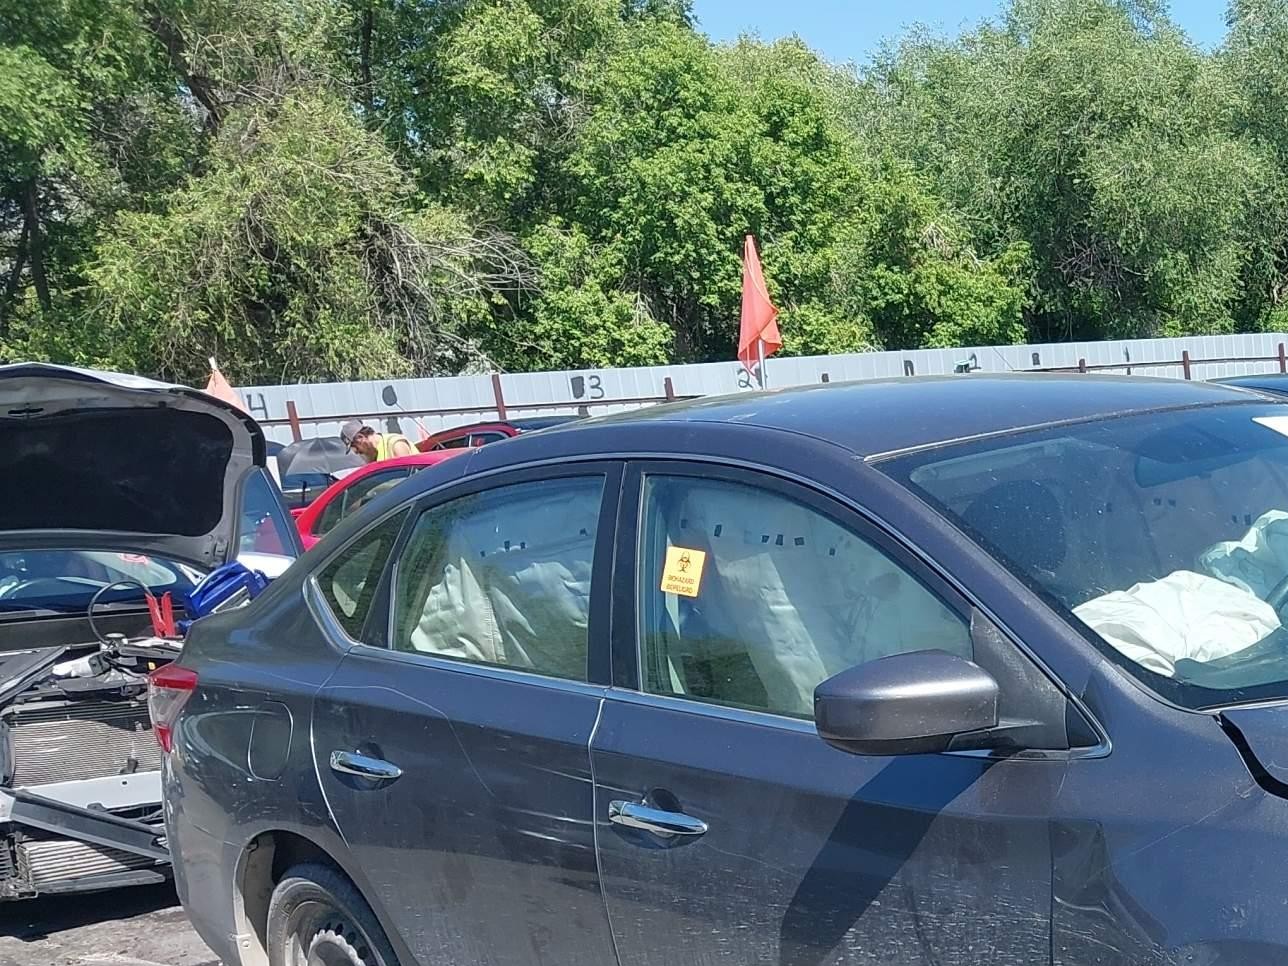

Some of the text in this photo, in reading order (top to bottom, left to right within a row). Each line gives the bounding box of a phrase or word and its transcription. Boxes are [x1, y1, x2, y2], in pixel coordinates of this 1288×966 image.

[588, 375, 605, 399] 3
[736, 368, 753, 388] 2
[246, 393, 268, 419] 4
